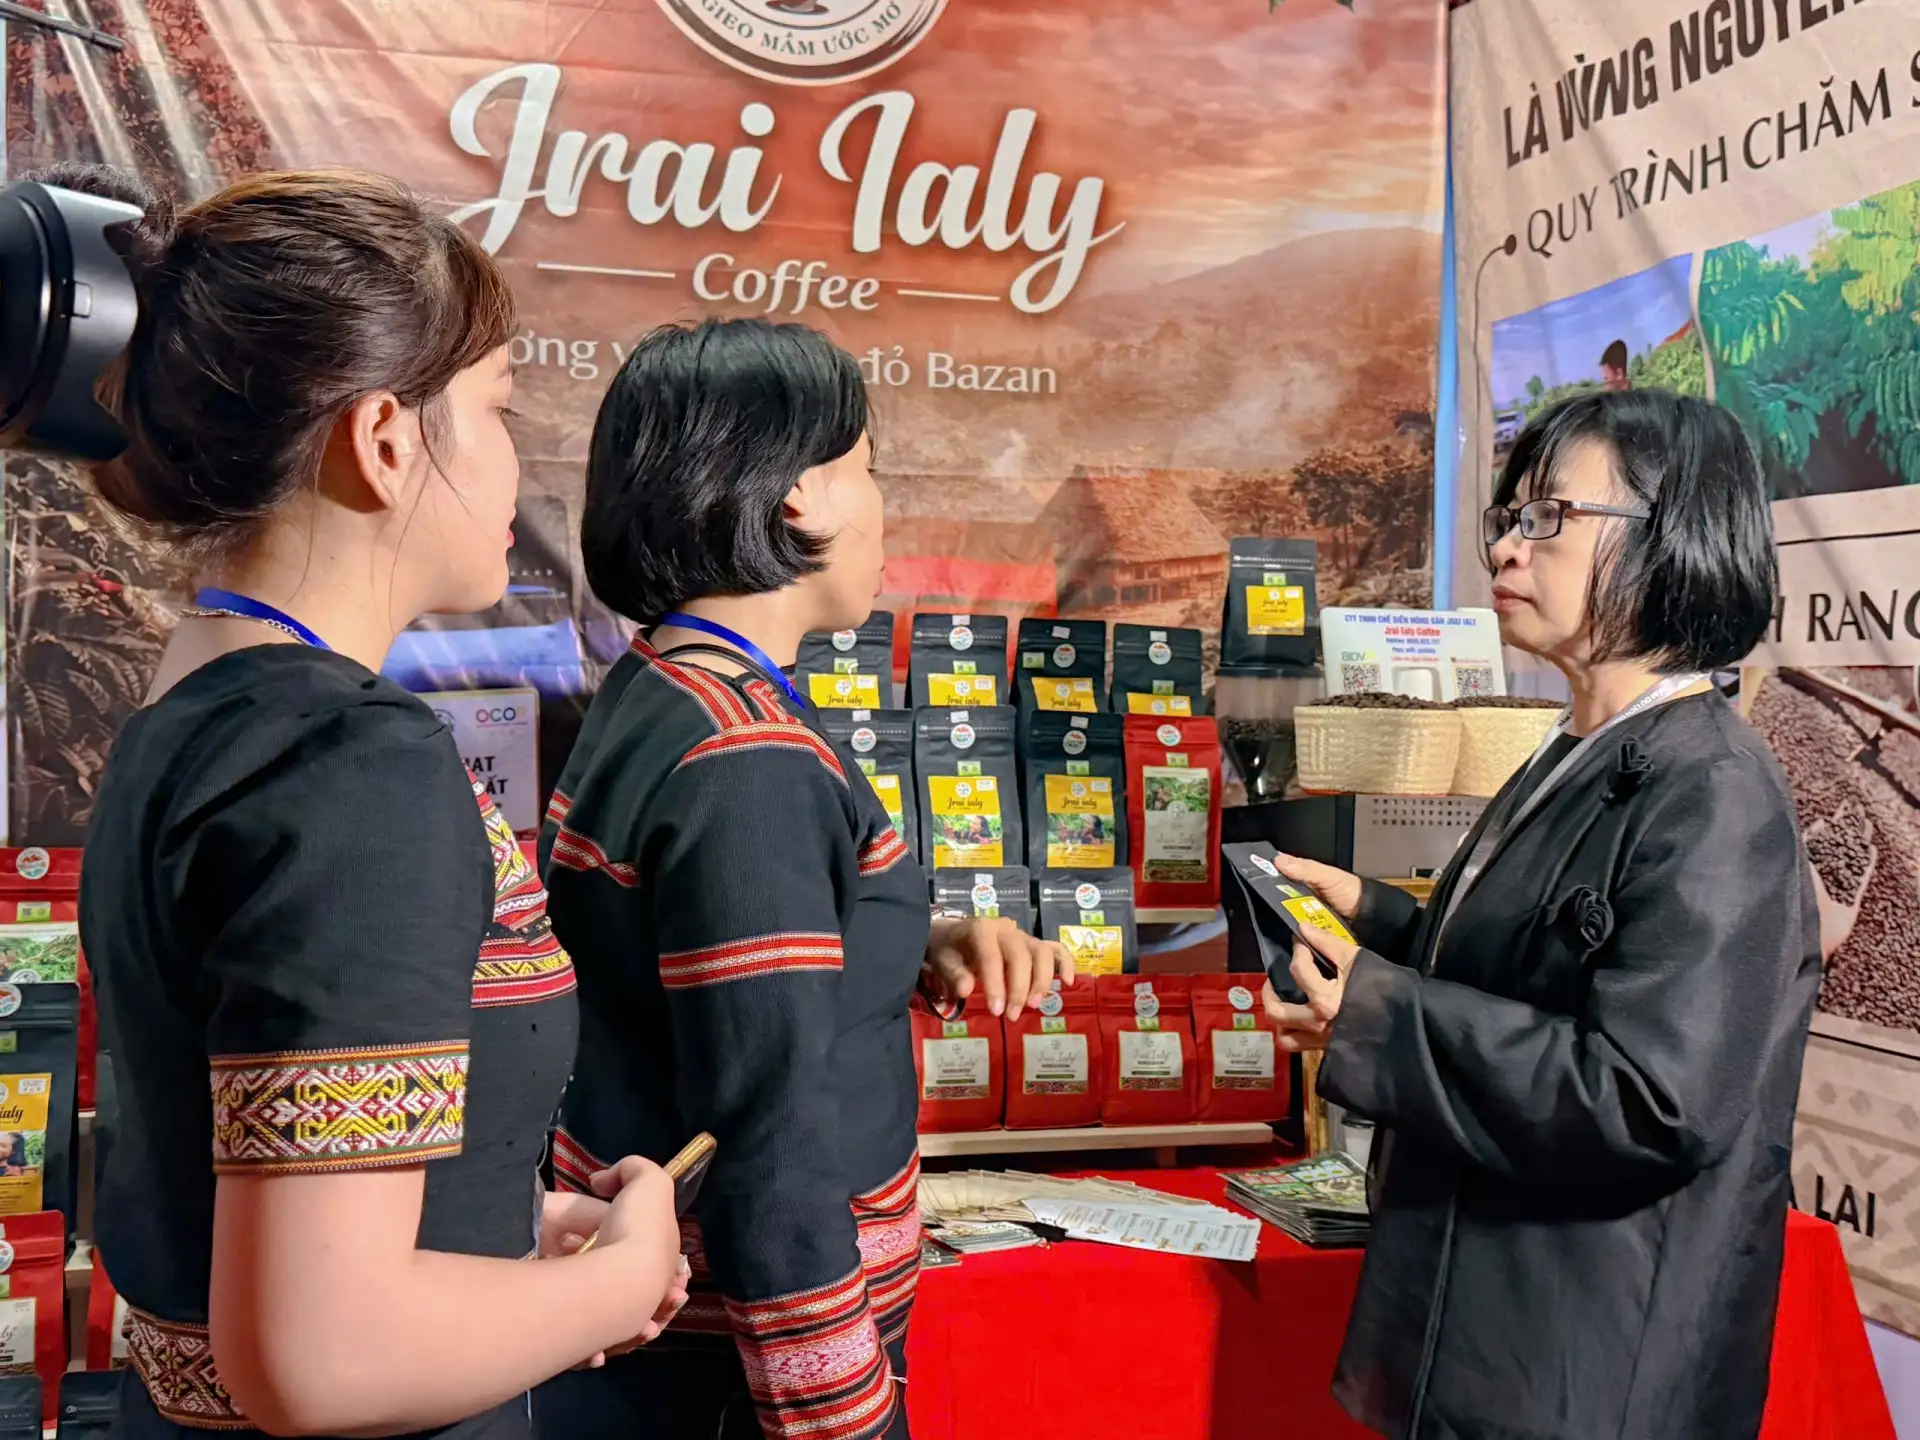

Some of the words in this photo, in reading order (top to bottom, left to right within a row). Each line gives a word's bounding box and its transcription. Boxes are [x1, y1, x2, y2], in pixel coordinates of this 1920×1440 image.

[701, 0, 754, 39] GIEO
[1503, 81, 1549, 170] LÀ
[444, 62, 783, 257] Jrai
[819, 90, 1126, 314] Ialy
[1527, 186, 1598, 259] QUY
[1609, 136, 1728, 220] TRÌNH
[1743, 67, 1893, 170] CHĂM
[692, 252, 880, 315] Coffee
[511, 329, 599, 381] ơng
[857, 345, 911, 386] đỏ
[927, 351, 1057, 394] Bazan
[1814, 1174, 1876, 1238] LAI
